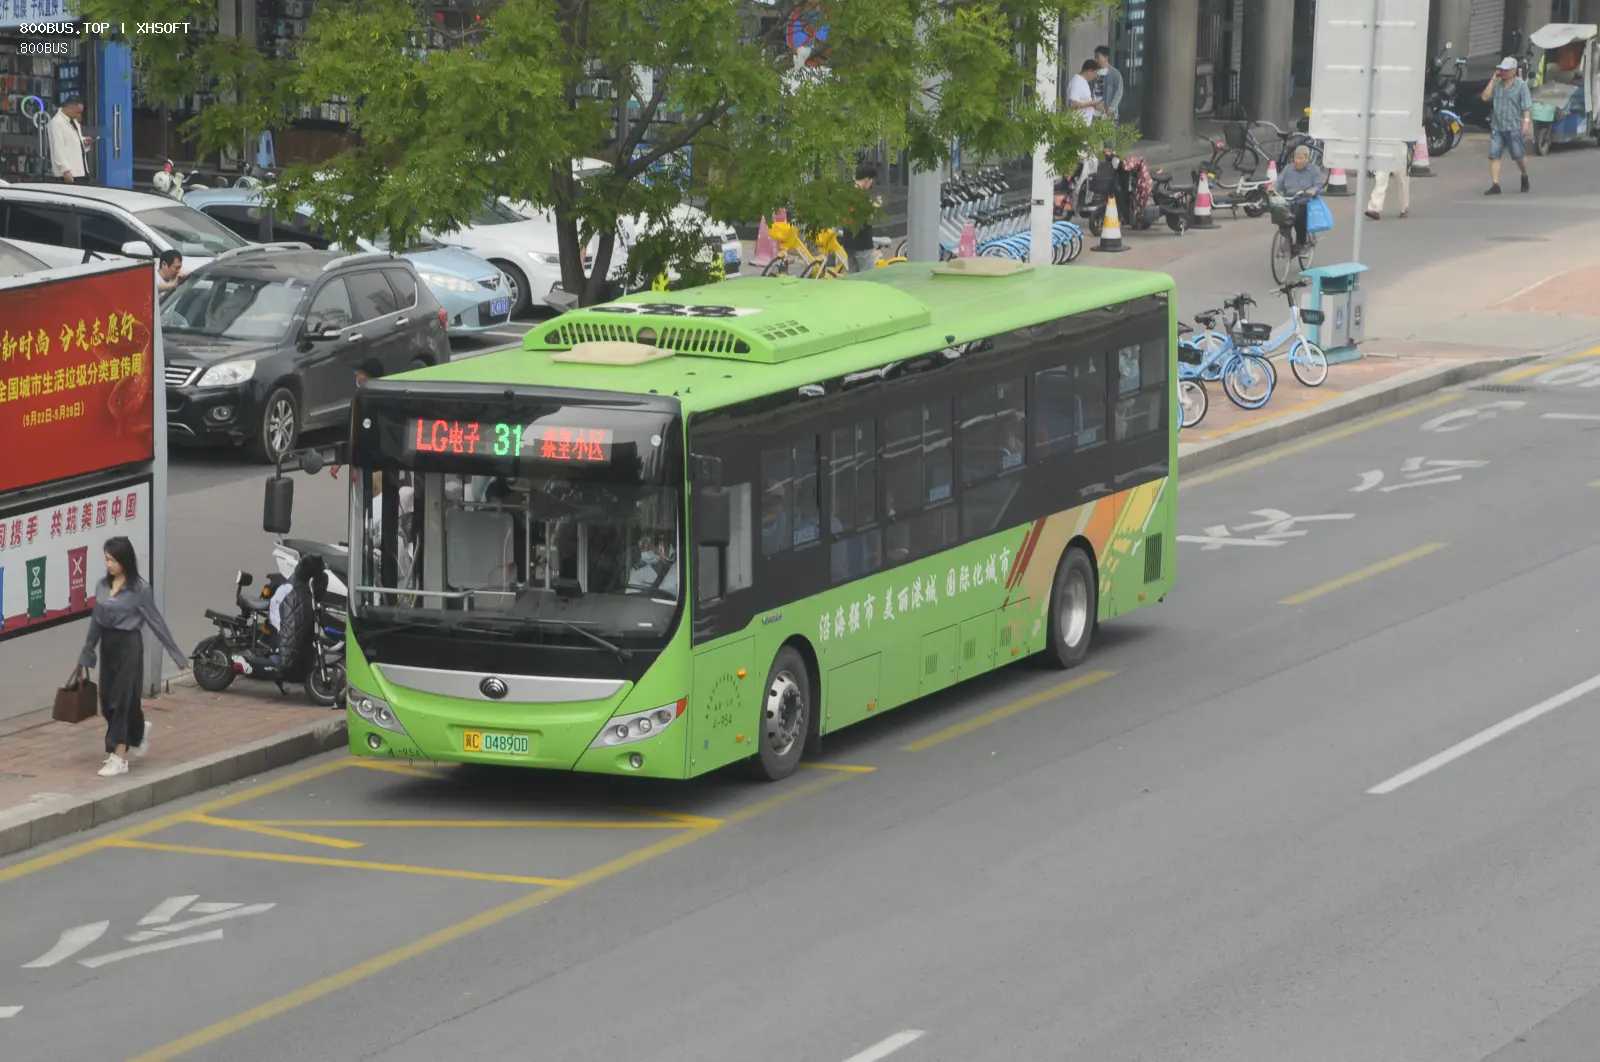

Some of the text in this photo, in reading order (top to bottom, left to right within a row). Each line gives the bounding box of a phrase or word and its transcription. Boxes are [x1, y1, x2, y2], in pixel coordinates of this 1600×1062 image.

[59, 310, 136, 352] 分类志愿行
[0, 352, 144, 403] 全国城市生活垃圾分类宣传周
[416, 417, 481, 454] LG电子
[494, 422, 522, 457] 31
[50, 492, 137, 538] 共筑美丽中国
[945, 547, 1011, 597] 国际化城市
[484, 734, 528, 752] 04890D
